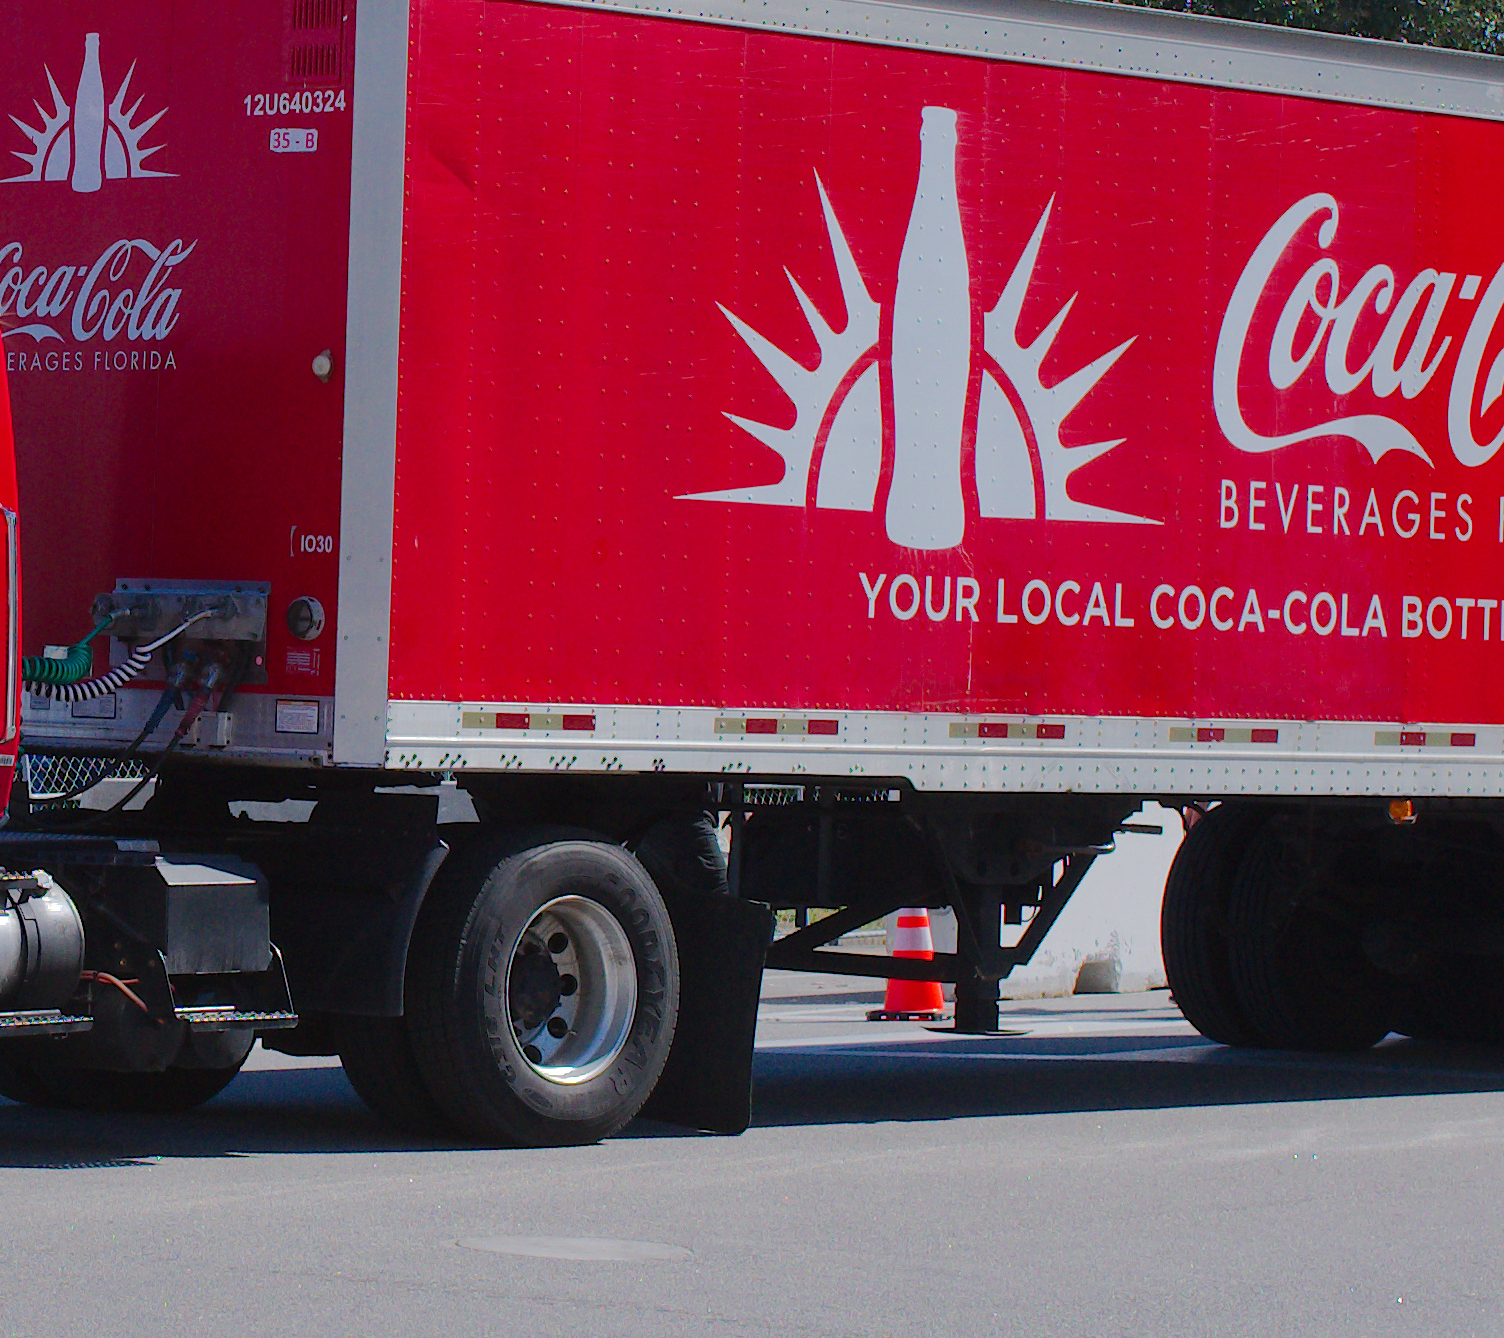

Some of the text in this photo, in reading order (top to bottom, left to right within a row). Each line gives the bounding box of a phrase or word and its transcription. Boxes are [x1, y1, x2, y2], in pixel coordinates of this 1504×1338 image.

[243, 88, 347, 117] 12U640324
[272, 131, 291, 150] 35
[305, 131, 315, 149] B
[6, 350, 177, 372] ERAGES FLORIDA
[1219, 478, 1473, 542] BEVERAGES
[857, 572, 981, 623] YOUR
[996, 578, 1135, 628] LOCAL
[1149, 583, 1388, 638] COCA-COLA
